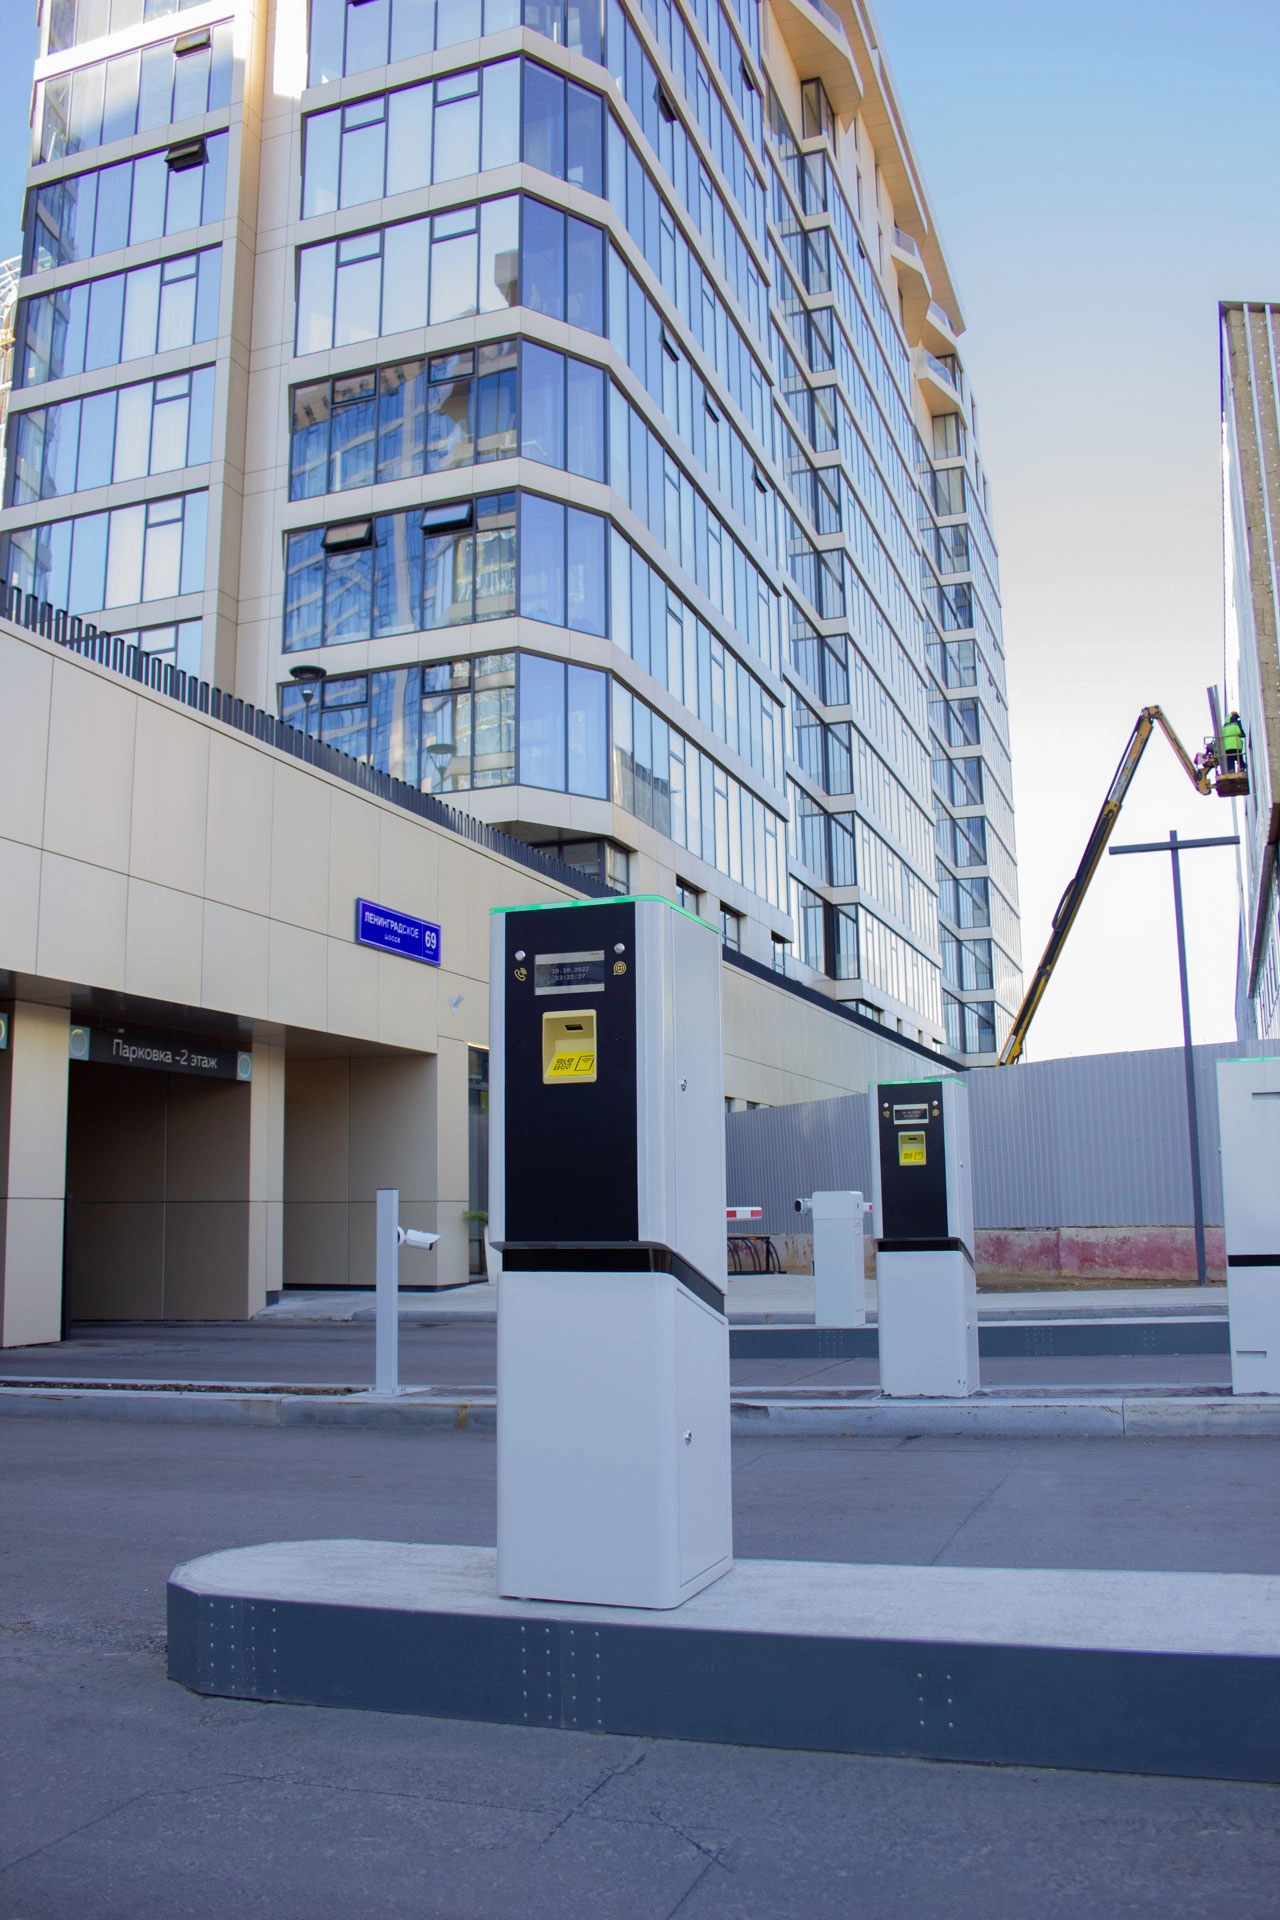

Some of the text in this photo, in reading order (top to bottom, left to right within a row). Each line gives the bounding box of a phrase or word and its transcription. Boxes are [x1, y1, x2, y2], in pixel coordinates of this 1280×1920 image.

[364, 911, 419, 939] ЛЕНИНГРАДСКОЕ
[425, 930, 437, 950] 69
[551, 966, 590, 974] 10.10.2022
[555, 973, 586, 981] 13:22:27
[112, 1038, 218, 1070] Парковка -2 этаж
